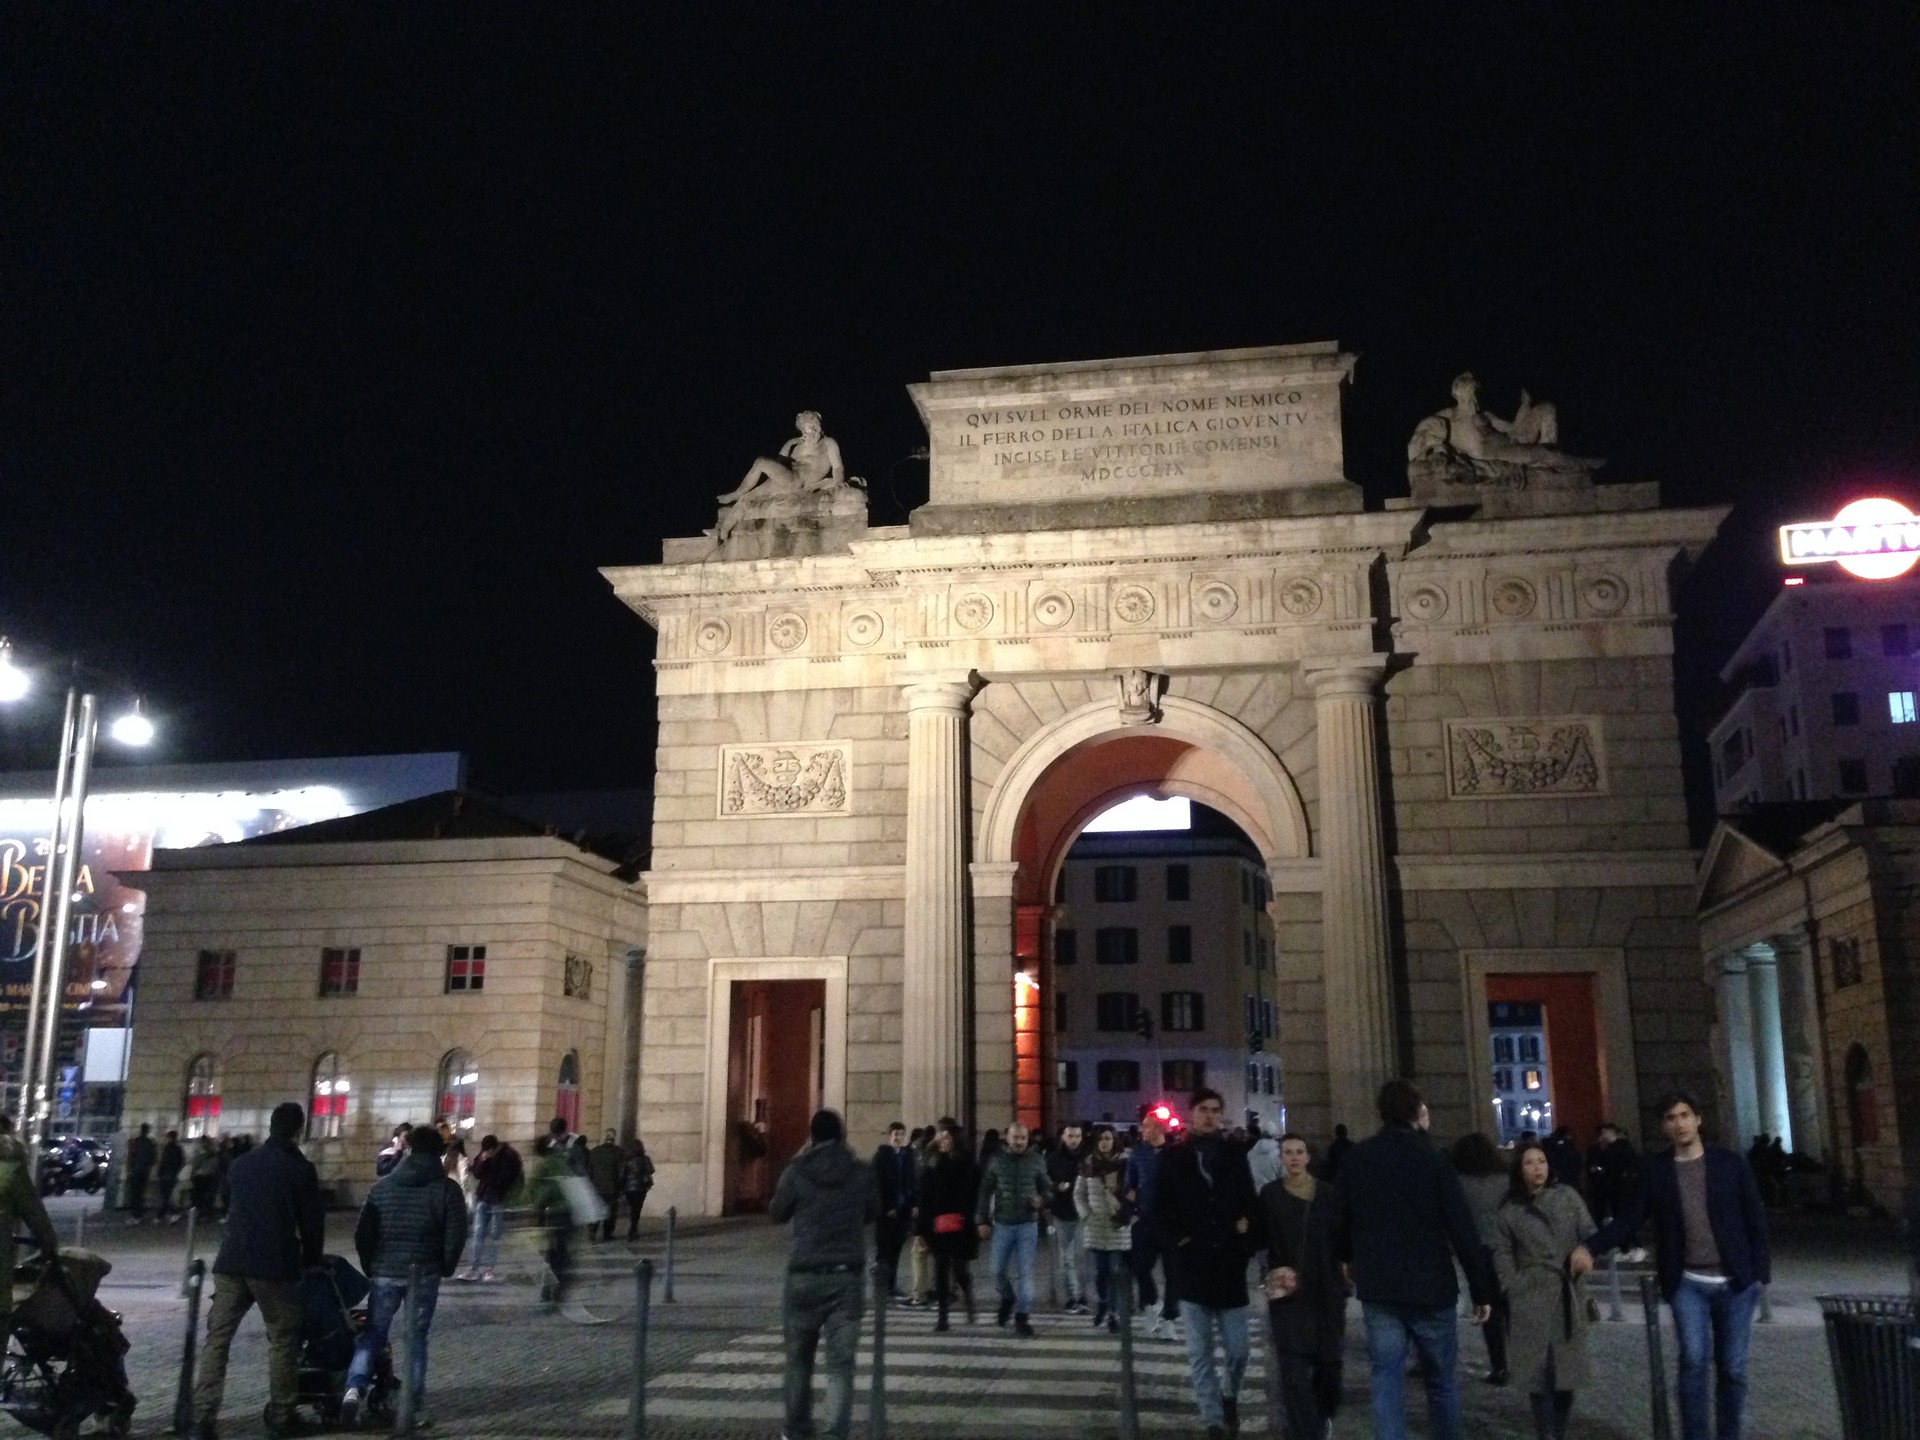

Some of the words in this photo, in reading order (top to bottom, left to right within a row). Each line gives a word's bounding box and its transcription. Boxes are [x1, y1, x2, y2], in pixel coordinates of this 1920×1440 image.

[967, 412, 1000, 428] QVI
[1059, 404, 1113, 420] ORME
[1120, 402, 1154, 416] DEL
[1162, 397, 1217, 413] NOME
[1226, 391, 1302, 409] NEMICO
[960, 434, 977, 447] IL
[983, 430, 1045, 446] FERRO
[1052, 426, 1113, 441] DELLA
[1123, 420, 1199, 436] ITALICA
[1206, 412, 1308, 431] GIOVENTV
[994, 450, 1054, 466] INCISE
[1062, 448, 1084, 462] LE
